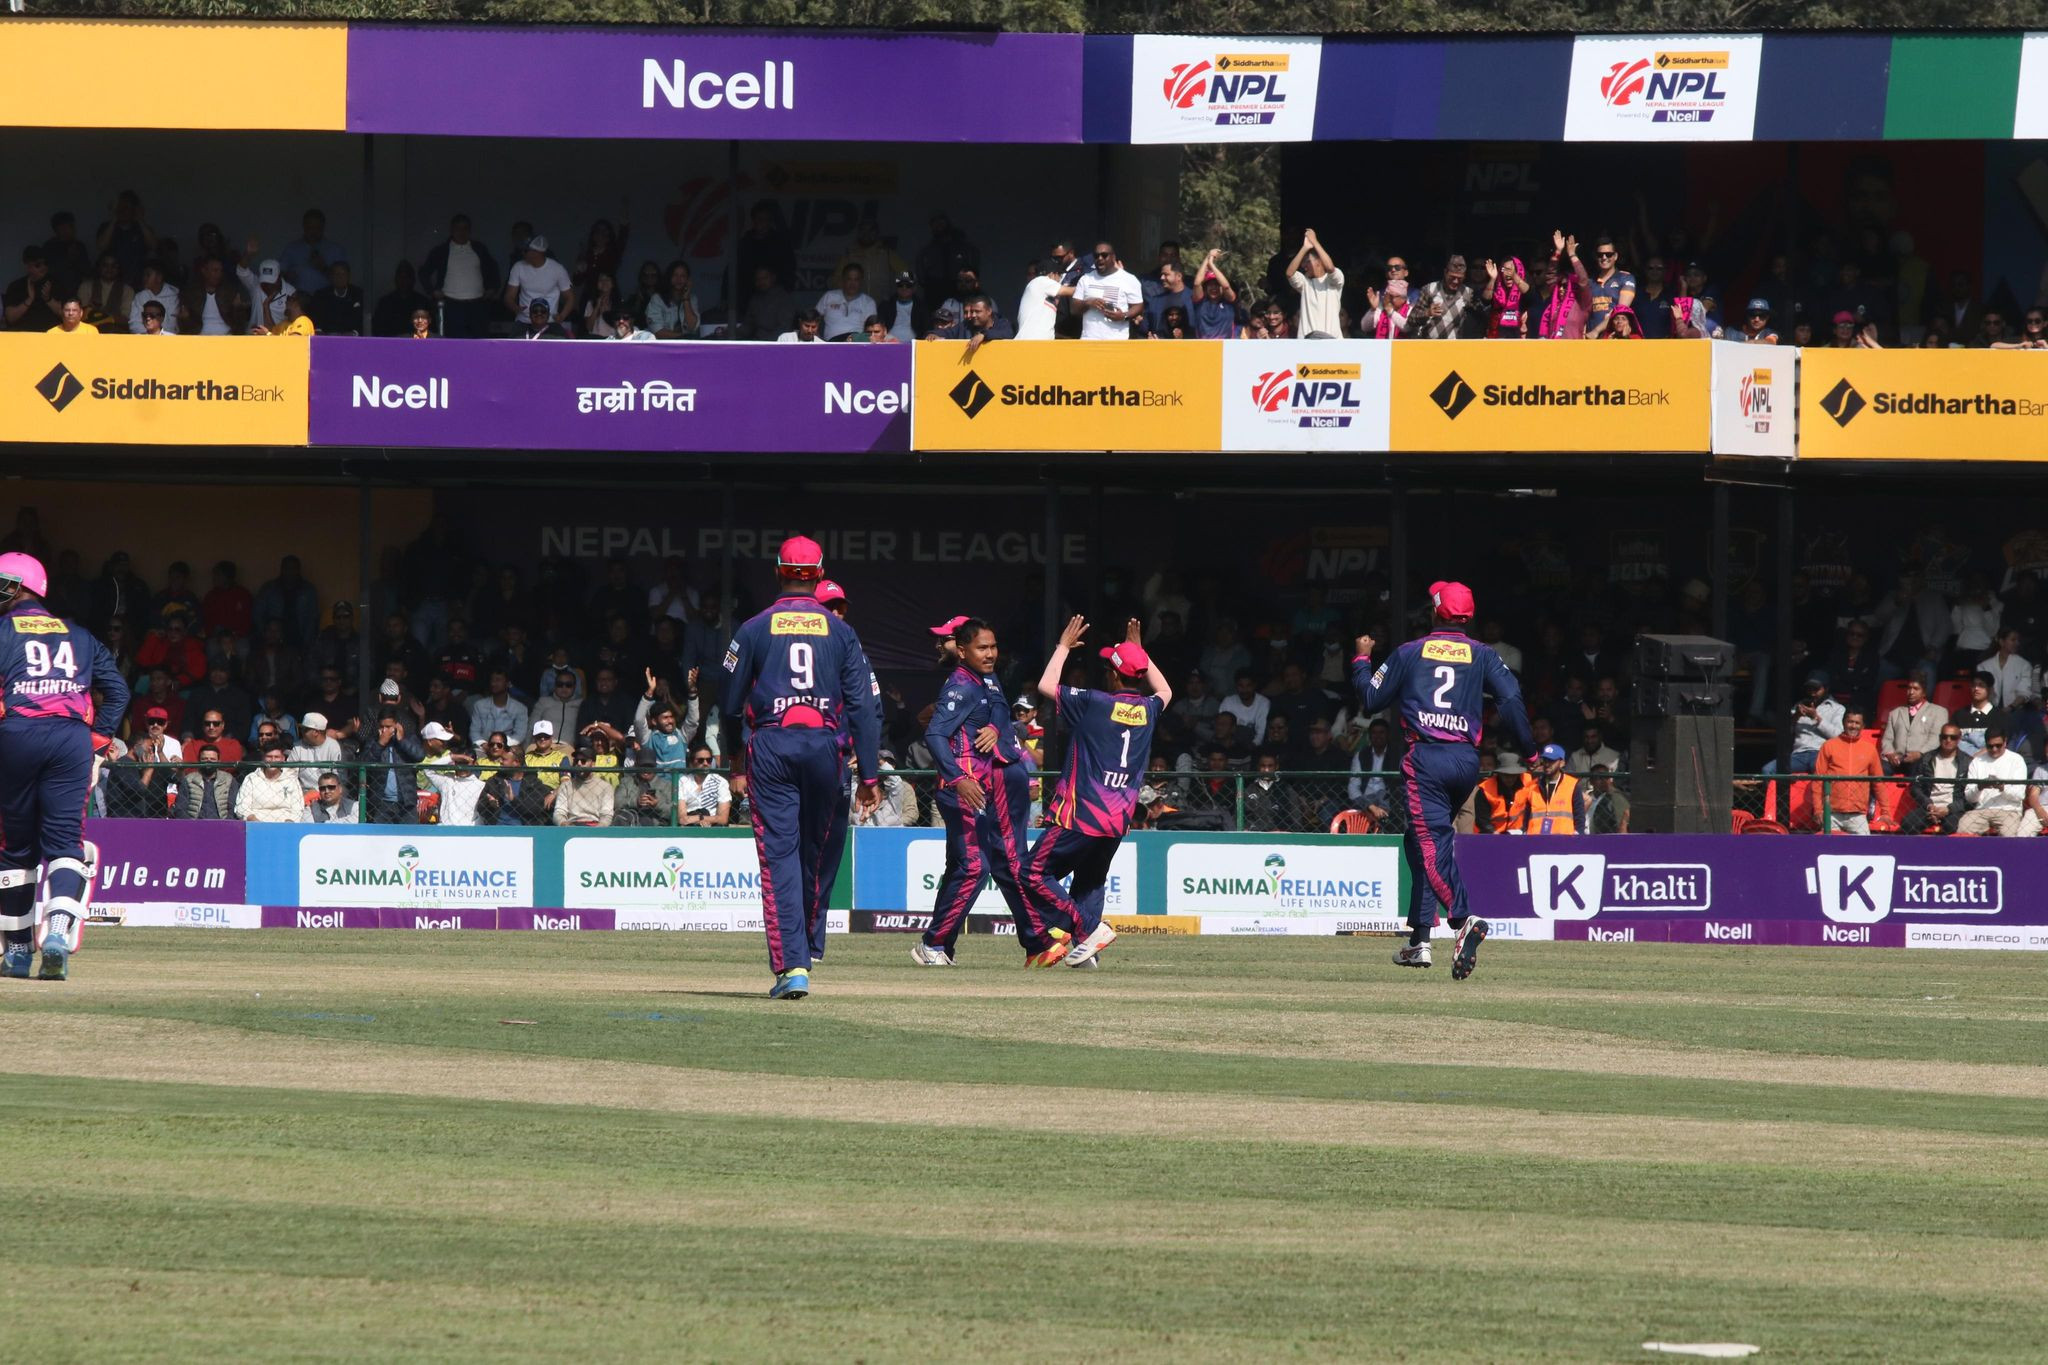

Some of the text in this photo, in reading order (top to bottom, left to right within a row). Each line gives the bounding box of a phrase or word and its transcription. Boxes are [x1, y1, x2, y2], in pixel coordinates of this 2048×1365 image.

[643, 58, 793, 109] Ncell
[1208, 75, 1286, 103] NPL
[1645, 72, 1726, 100] NPL
[1229, 114, 1260, 124] Ncell
[1666, 110, 1699, 122] Ncell
[353, 375, 449, 408] Ncell
[576, 380, 696, 413] हाम्रो जित
[824, 382, 909, 414] Ncel
[1292, 383, 1360, 407] NPL
[1752, 387, 1772, 412] NPL
[1311, 417, 1339, 427] Ncell
[542, 526, 1087, 564] NEPAL PREIER LEAGUE
[25, 640, 78, 678] 94
[790, 642, 814, 690] 9
[1434, 666, 1455, 708] 2
[1120, 729, 1130, 768] 1
[102, 862, 226, 890] yle.com
[315, 868, 517, 887] SANIMA RELIANCE
[580, 871, 762, 889] SANIMA RELIANC
[415, 889, 517, 899] LIFE INSURANCE
[679, 891, 762, 900] LIFE INSURAN
[1183, 877, 1382, 897] SANIMA RELIANCE
[1613, 875, 1697, 900] khalti
[1904, 877, 1988, 903] khalti
[1281, 898, 1382, 909] LIFE INSURANCE
[191, 907, 230, 923] SPIL
[297, 911, 344, 928] Ncell
[416, 916, 461, 929] Ncell
[533, 914, 581, 930] Ncell
[1337, 921, 1400, 931] SIDDHARTHA
[1588, 927, 1634, 942] Ncell
[1705, 922, 1752, 940] Ncell
[1823, 925, 1870, 943] Ncell
